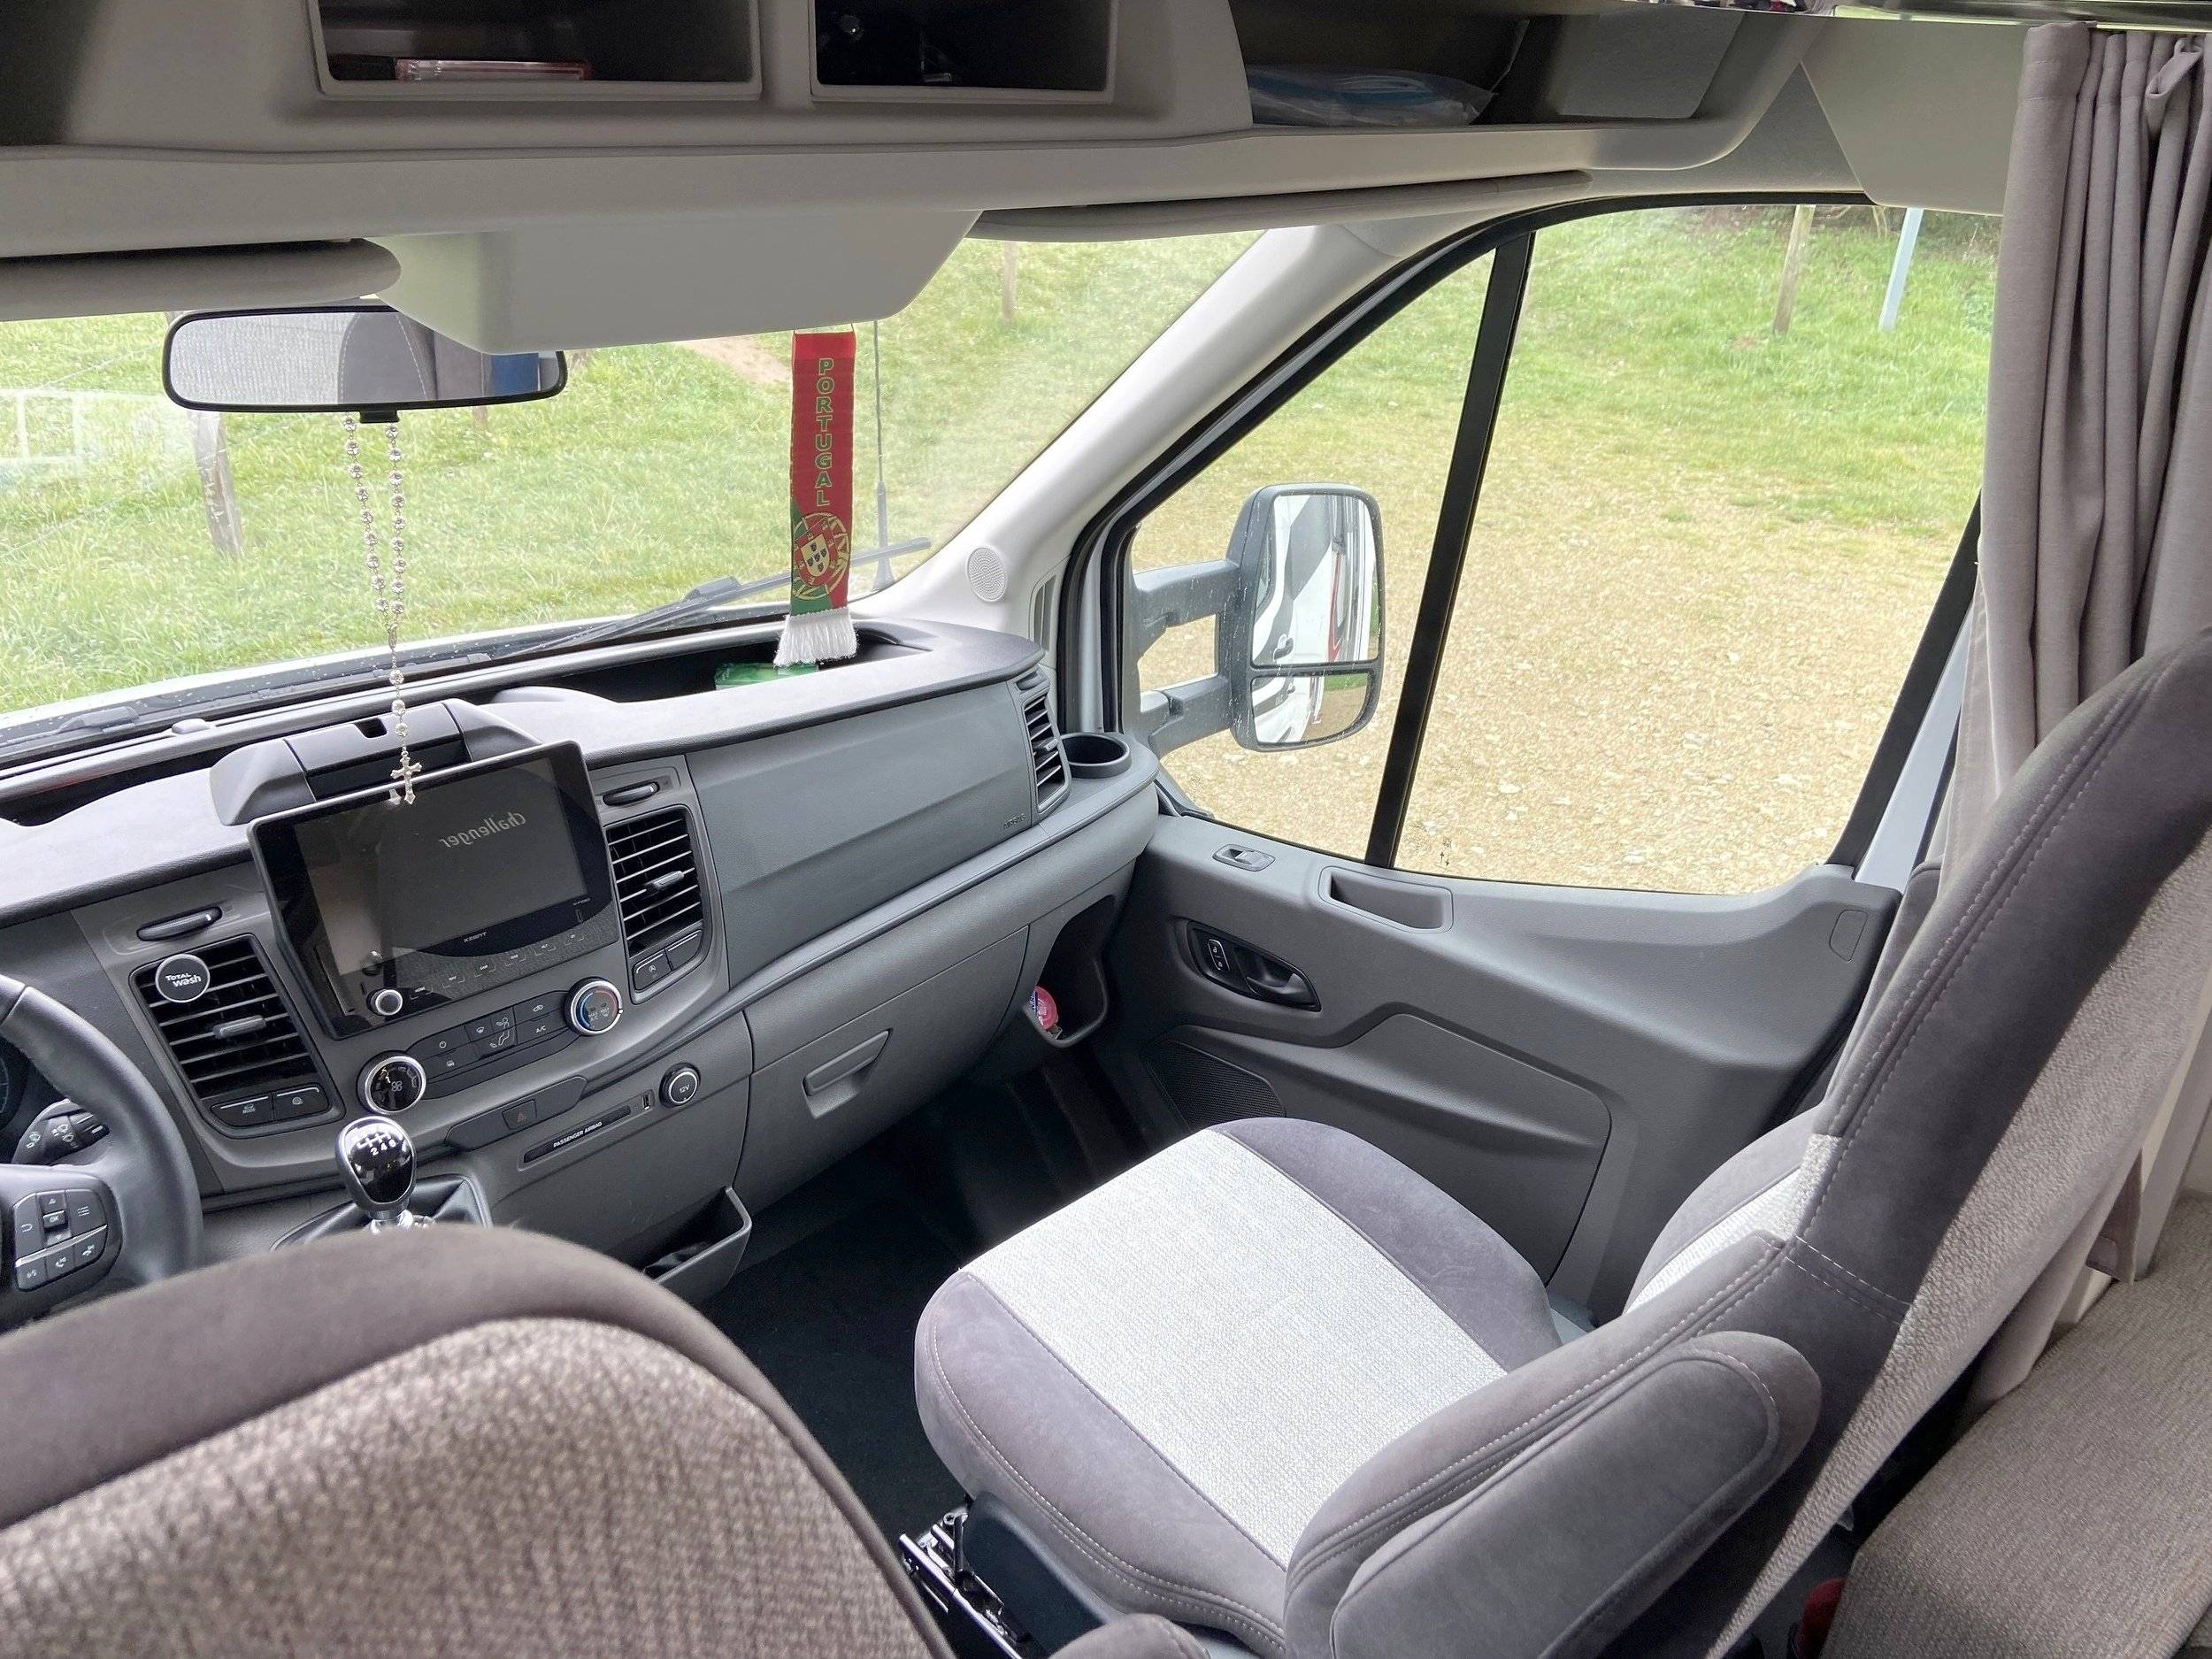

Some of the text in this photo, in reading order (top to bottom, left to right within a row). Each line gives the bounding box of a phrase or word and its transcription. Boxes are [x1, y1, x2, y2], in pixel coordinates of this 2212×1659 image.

[815, 358, 834, 506] PORTUGAL
[680, 1084, 689, 1093] 12V
[553, 1130, 584, 1148] PASSENGER
[50, 1214, 59, 1223] OK
